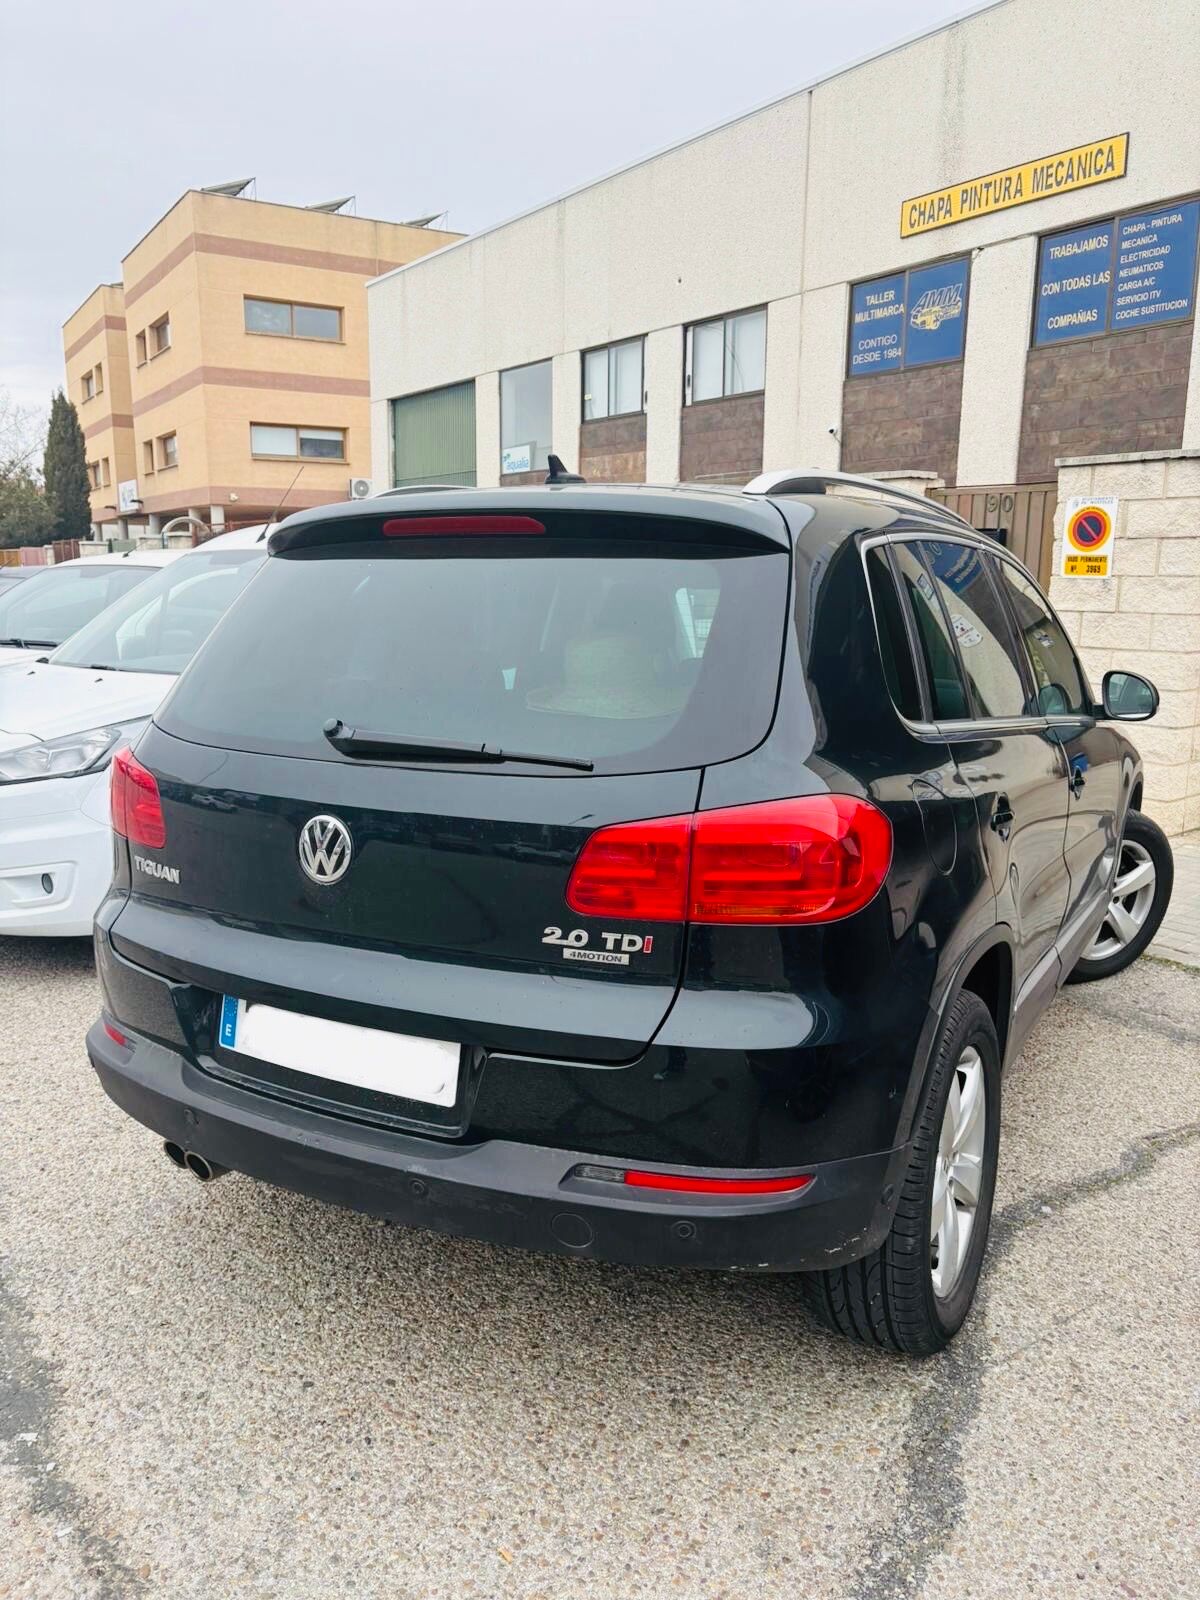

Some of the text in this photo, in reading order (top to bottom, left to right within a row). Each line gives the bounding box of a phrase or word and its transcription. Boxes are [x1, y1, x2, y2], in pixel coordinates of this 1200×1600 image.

[908, 144, 1115, 229] CHAPA PINTURA MECANICA
[1122, 222, 1146, 235] CHAPA
[1151, 214, 1183, 229] PINTURA
[1049, 235, 1109, 260] TRABAJAMOS
[1121, 234, 1158, 249] MECANICA
[1120, 245, 1171, 264] ELECTRICIDAD
[1119, 260, 1165, 278] NEUMATICOS
[1041, 270, 1111, 296] CON TODAS LAS
[1118, 276, 1156, 292] CARGA A/C
[866, 290, 896, 306] TALLER
[1116, 289, 1162, 306] SERVICIO ITV
[854, 303, 905, 324] MULTIMARCA
[1115, 298, 1188, 320] COCHE SUSTITUCION
[1047, 309, 1099, 329] COMPAÑIAS
[858, 334, 898, 350] CONTIGO
[852, 347, 902, 365] DESDE 1984
[987, 495, 1014, 512] 90
[134, 855, 181, 884] TIGUAN
[569, 951, 622, 963] 4MOTION
[225, 1023, 232, 1037] E
